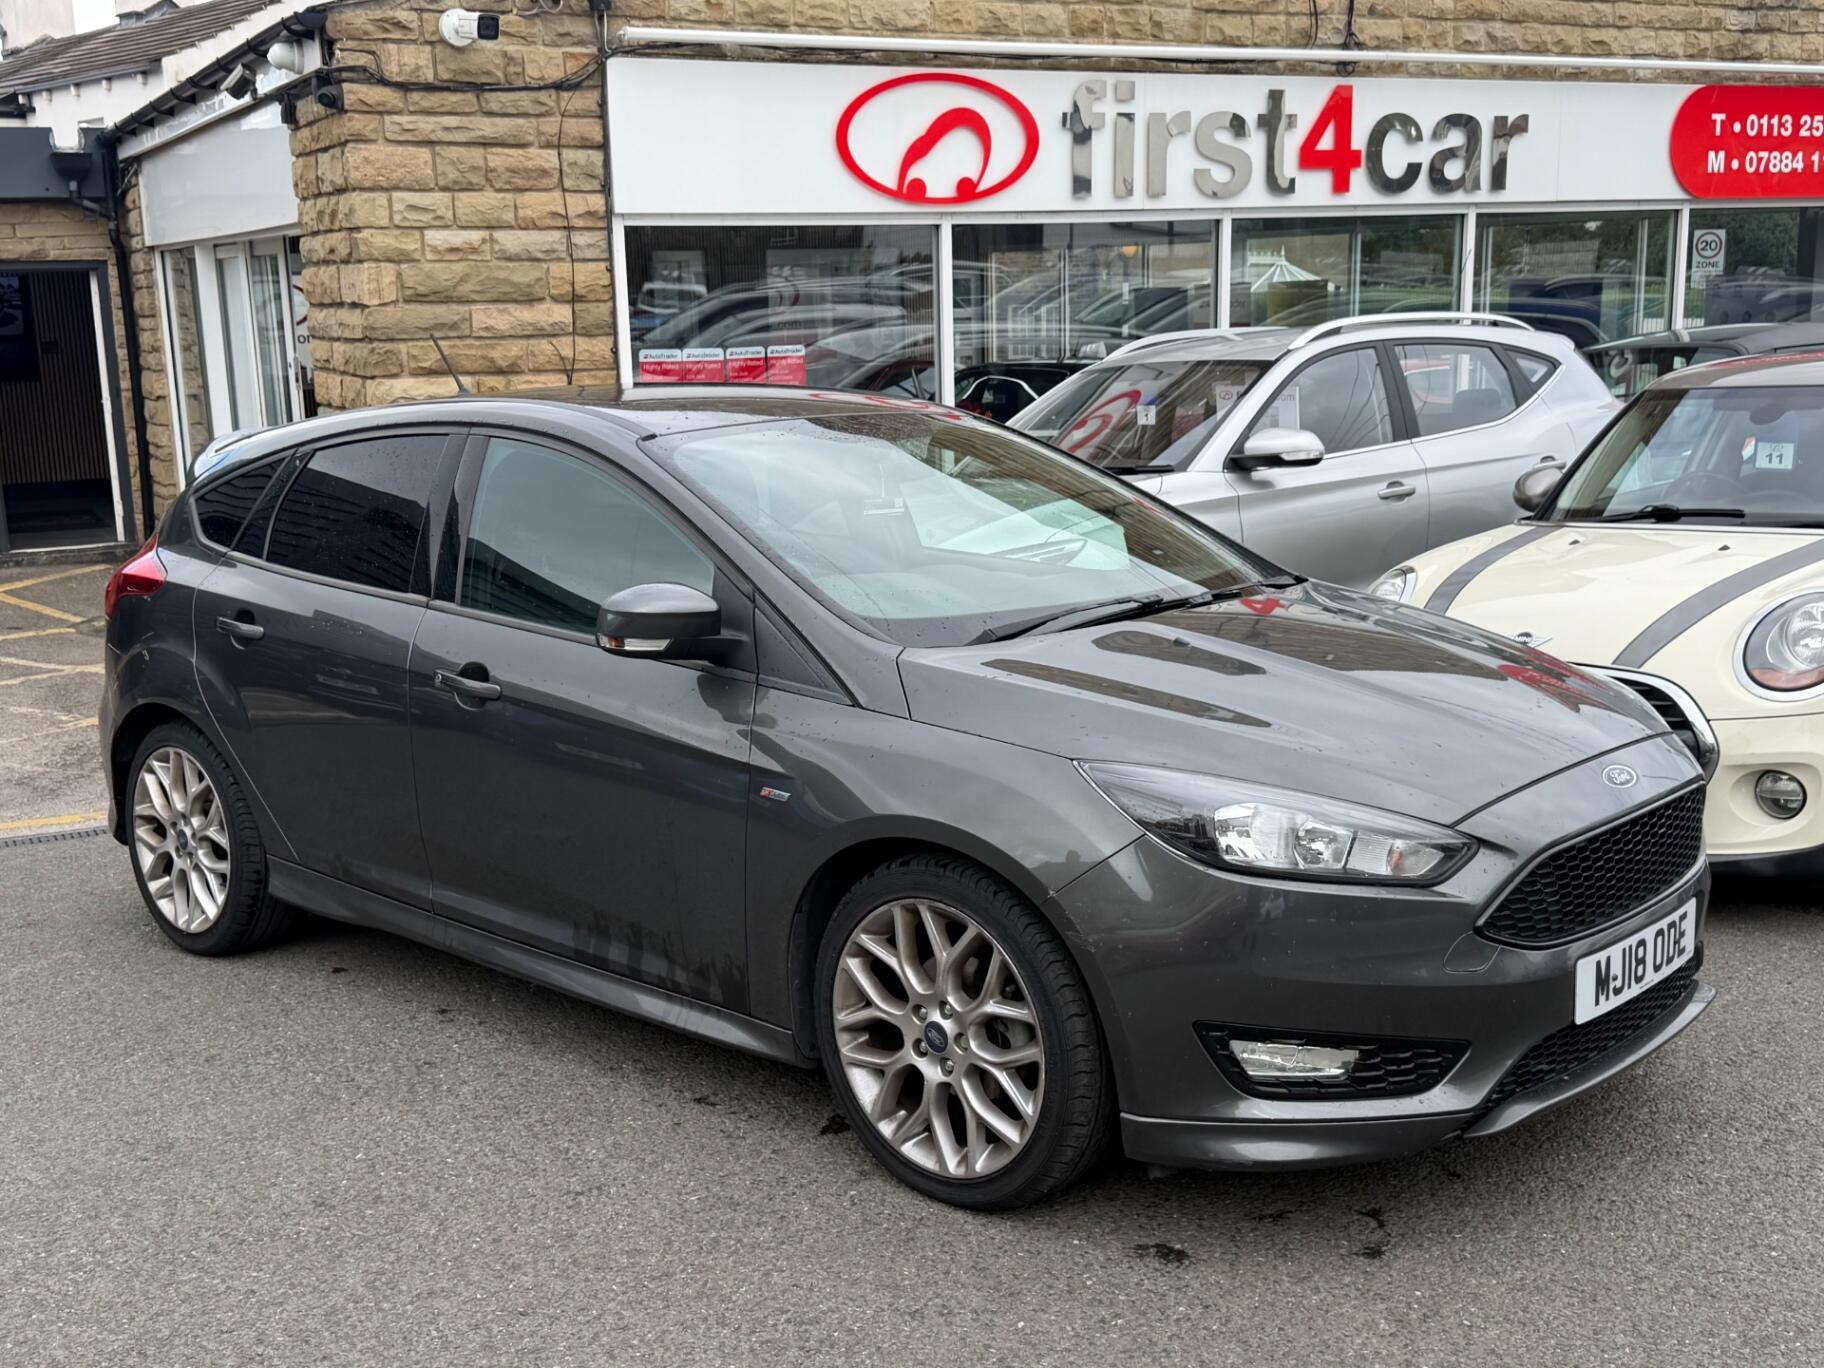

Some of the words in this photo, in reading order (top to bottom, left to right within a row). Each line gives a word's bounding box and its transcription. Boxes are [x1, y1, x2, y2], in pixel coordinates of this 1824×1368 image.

[1711, 113, 1726, 136] T
[1746, 114, 1793, 137] 0113
[1061, 79, 1530, 199] first4car
[1707, 150, 1726, 173] M
[1745, 151, 1804, 173] 07884
[1811, 151, 1824, 173] 1
[1700, 240, 1718, 251] 20
[1695, 261, 1720, 269] ZONE
[1765, 452, 1784, 465] 11
[1595, 938, 1647, 1008] MJ18
[1653, 911, 1688, 974] ODE
